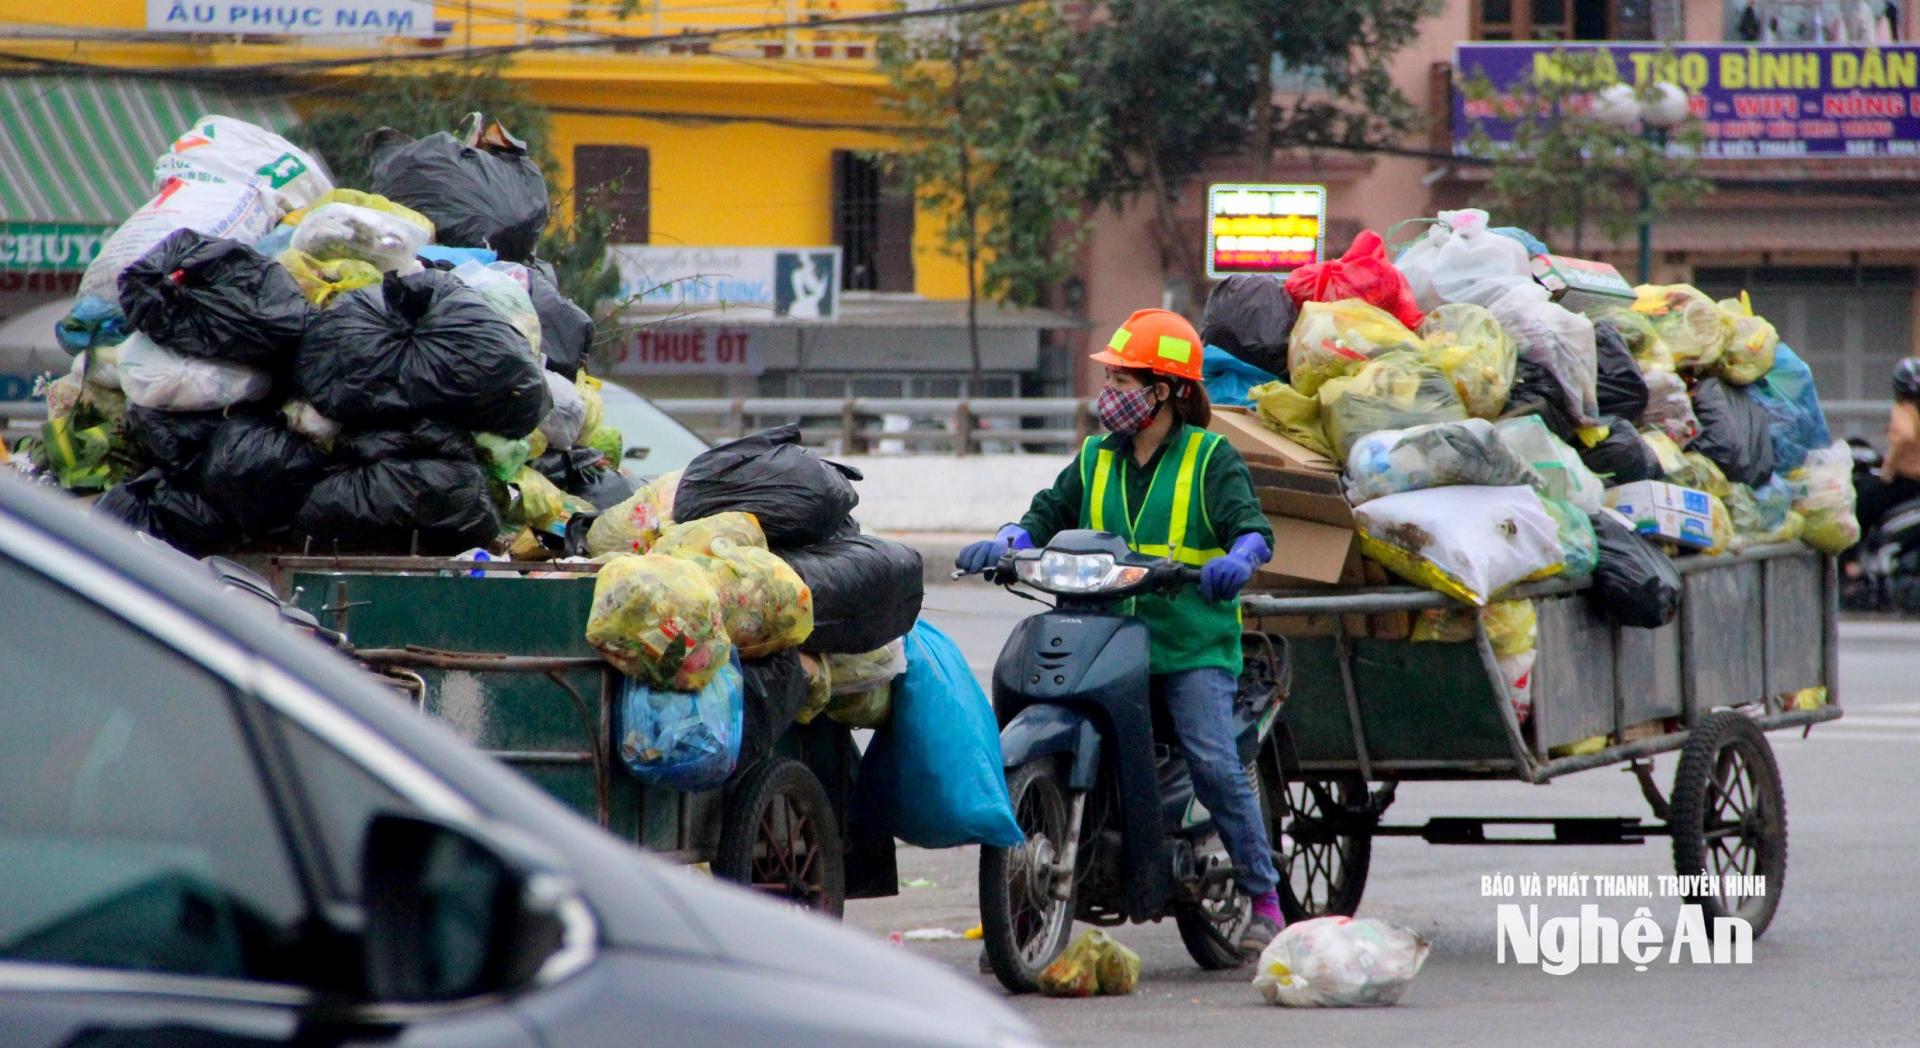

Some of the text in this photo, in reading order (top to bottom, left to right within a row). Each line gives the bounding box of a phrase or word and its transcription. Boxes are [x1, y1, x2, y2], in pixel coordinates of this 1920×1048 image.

[229, 6, 323, 30] PHỤC
[336, 9, 414, 29] NAM
[1719, 47, 1820, 89] BÌNH
[1831, 47, 1918, 89] DÂN
[1733, 93, 1798, 118] WIFI
[0, 233, 99, 263] CHUY
[637, 326, 706, 364] THUÊ
